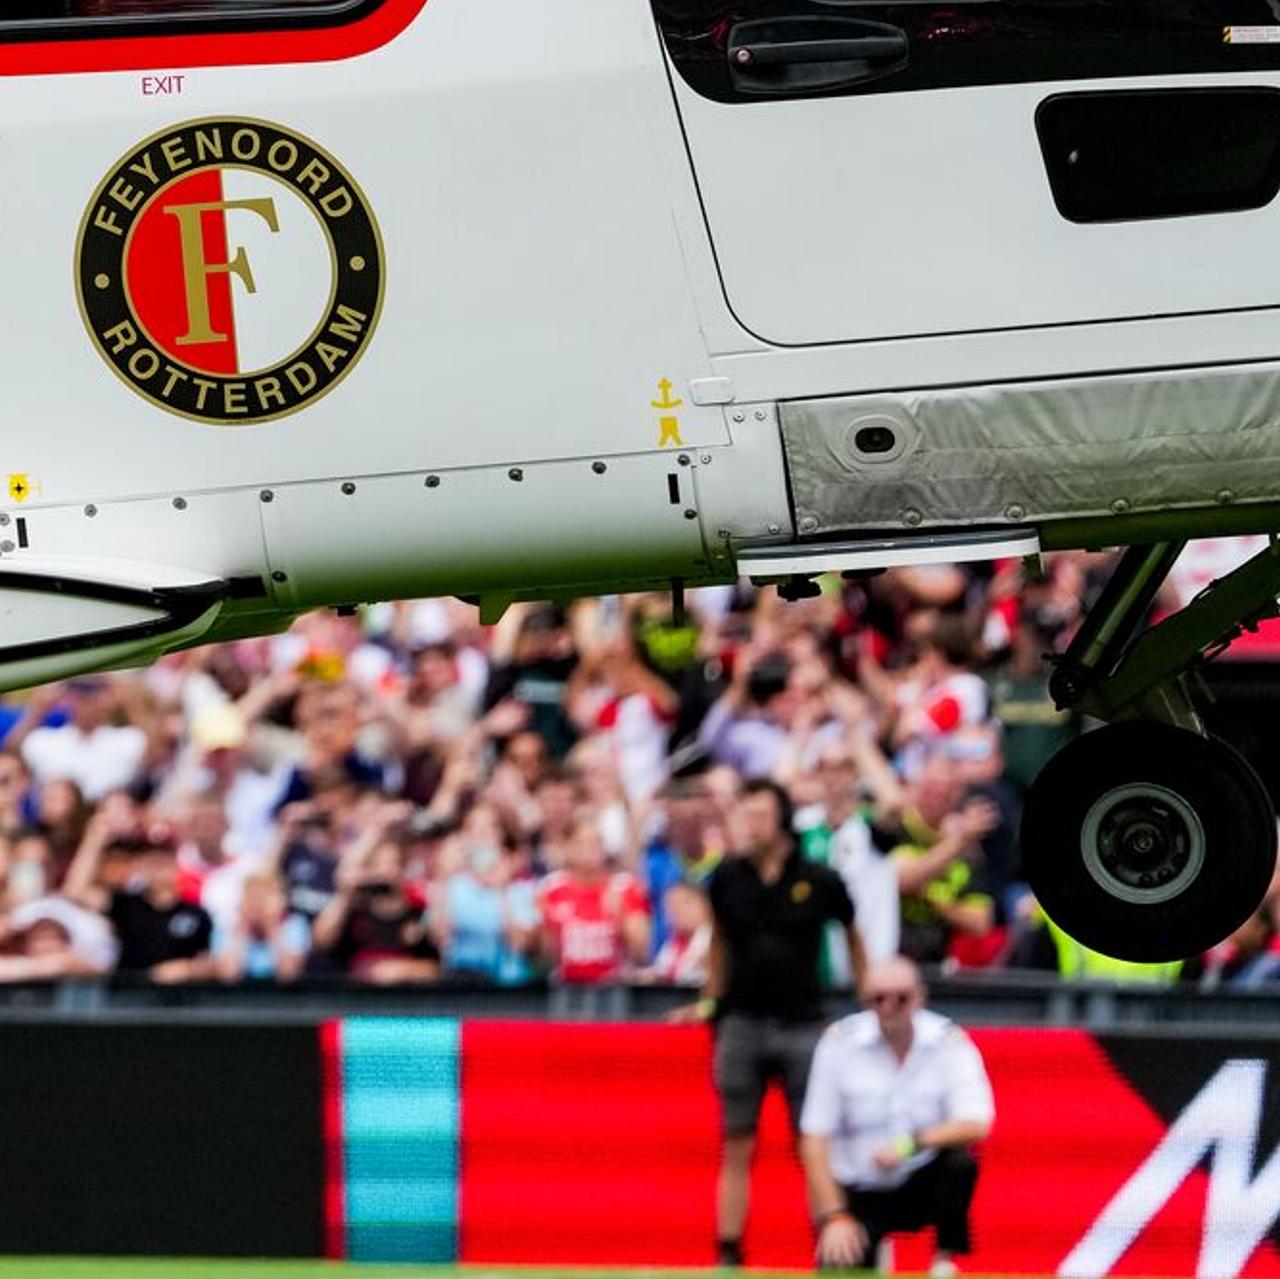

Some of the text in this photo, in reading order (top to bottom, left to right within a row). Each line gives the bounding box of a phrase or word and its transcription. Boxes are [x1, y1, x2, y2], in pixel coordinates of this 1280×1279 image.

[142, 75, 185, 95] EXIT
[94, 127, 355, 238] FEYENOORD
[102, 302, 369, 415] ROTTERDAM
